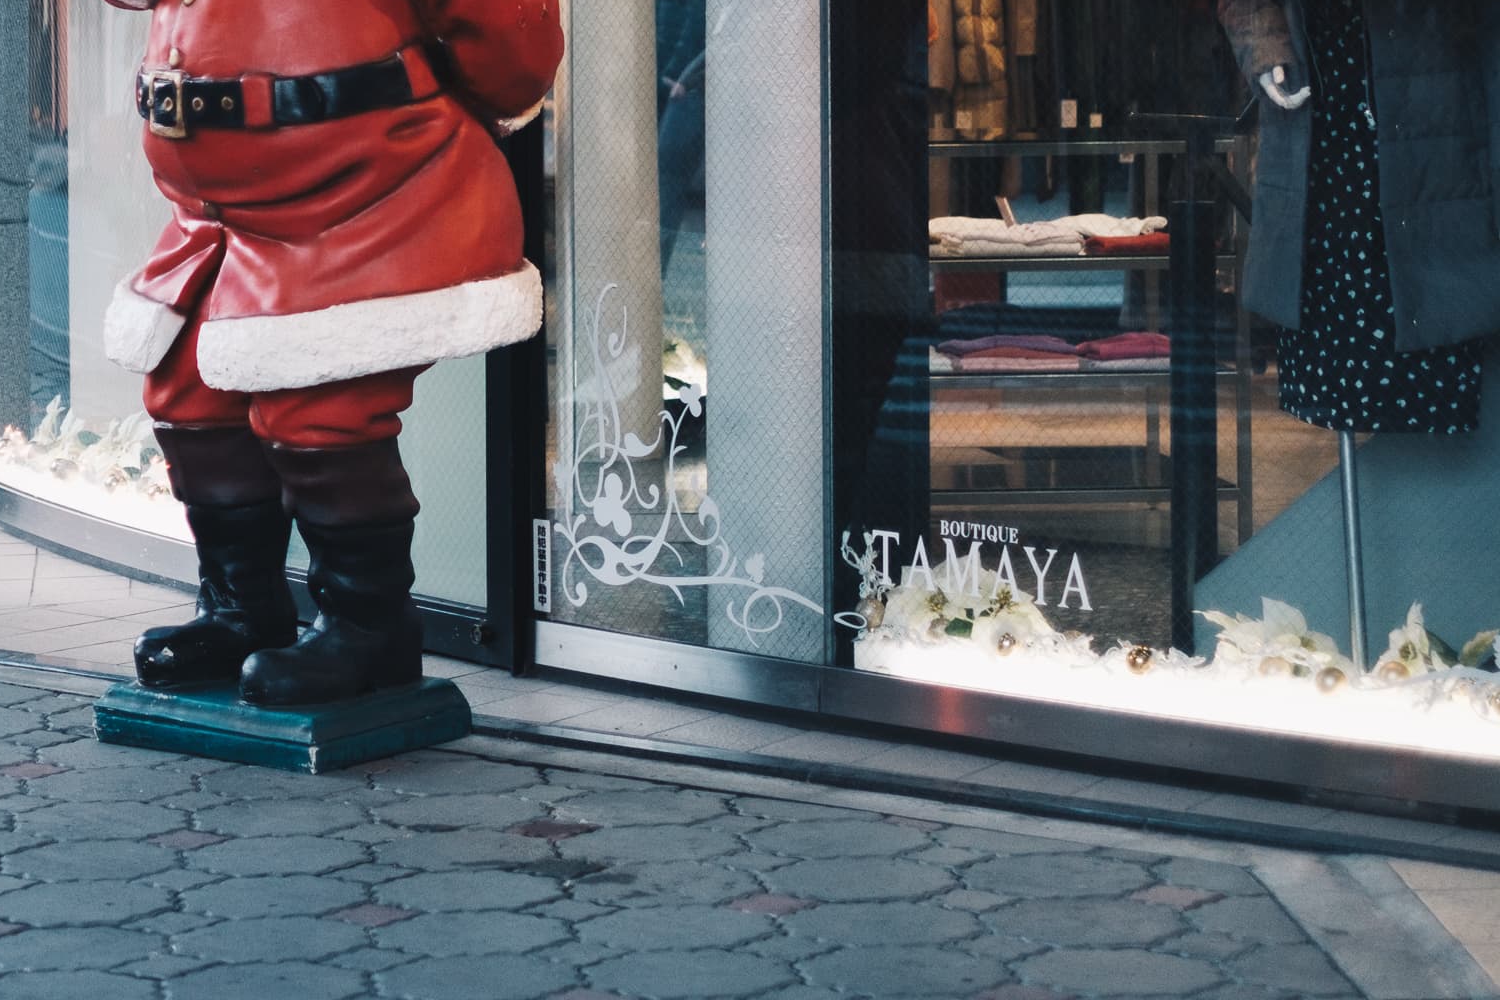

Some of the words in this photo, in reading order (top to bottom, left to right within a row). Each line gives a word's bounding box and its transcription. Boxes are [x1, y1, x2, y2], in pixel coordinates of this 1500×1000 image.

[537, 525, 547, 607] 防犯装置作動中
[872, 529, 1094, 611] TAMAYA
[939, 519, 1020, 545] BOUTIQUE
